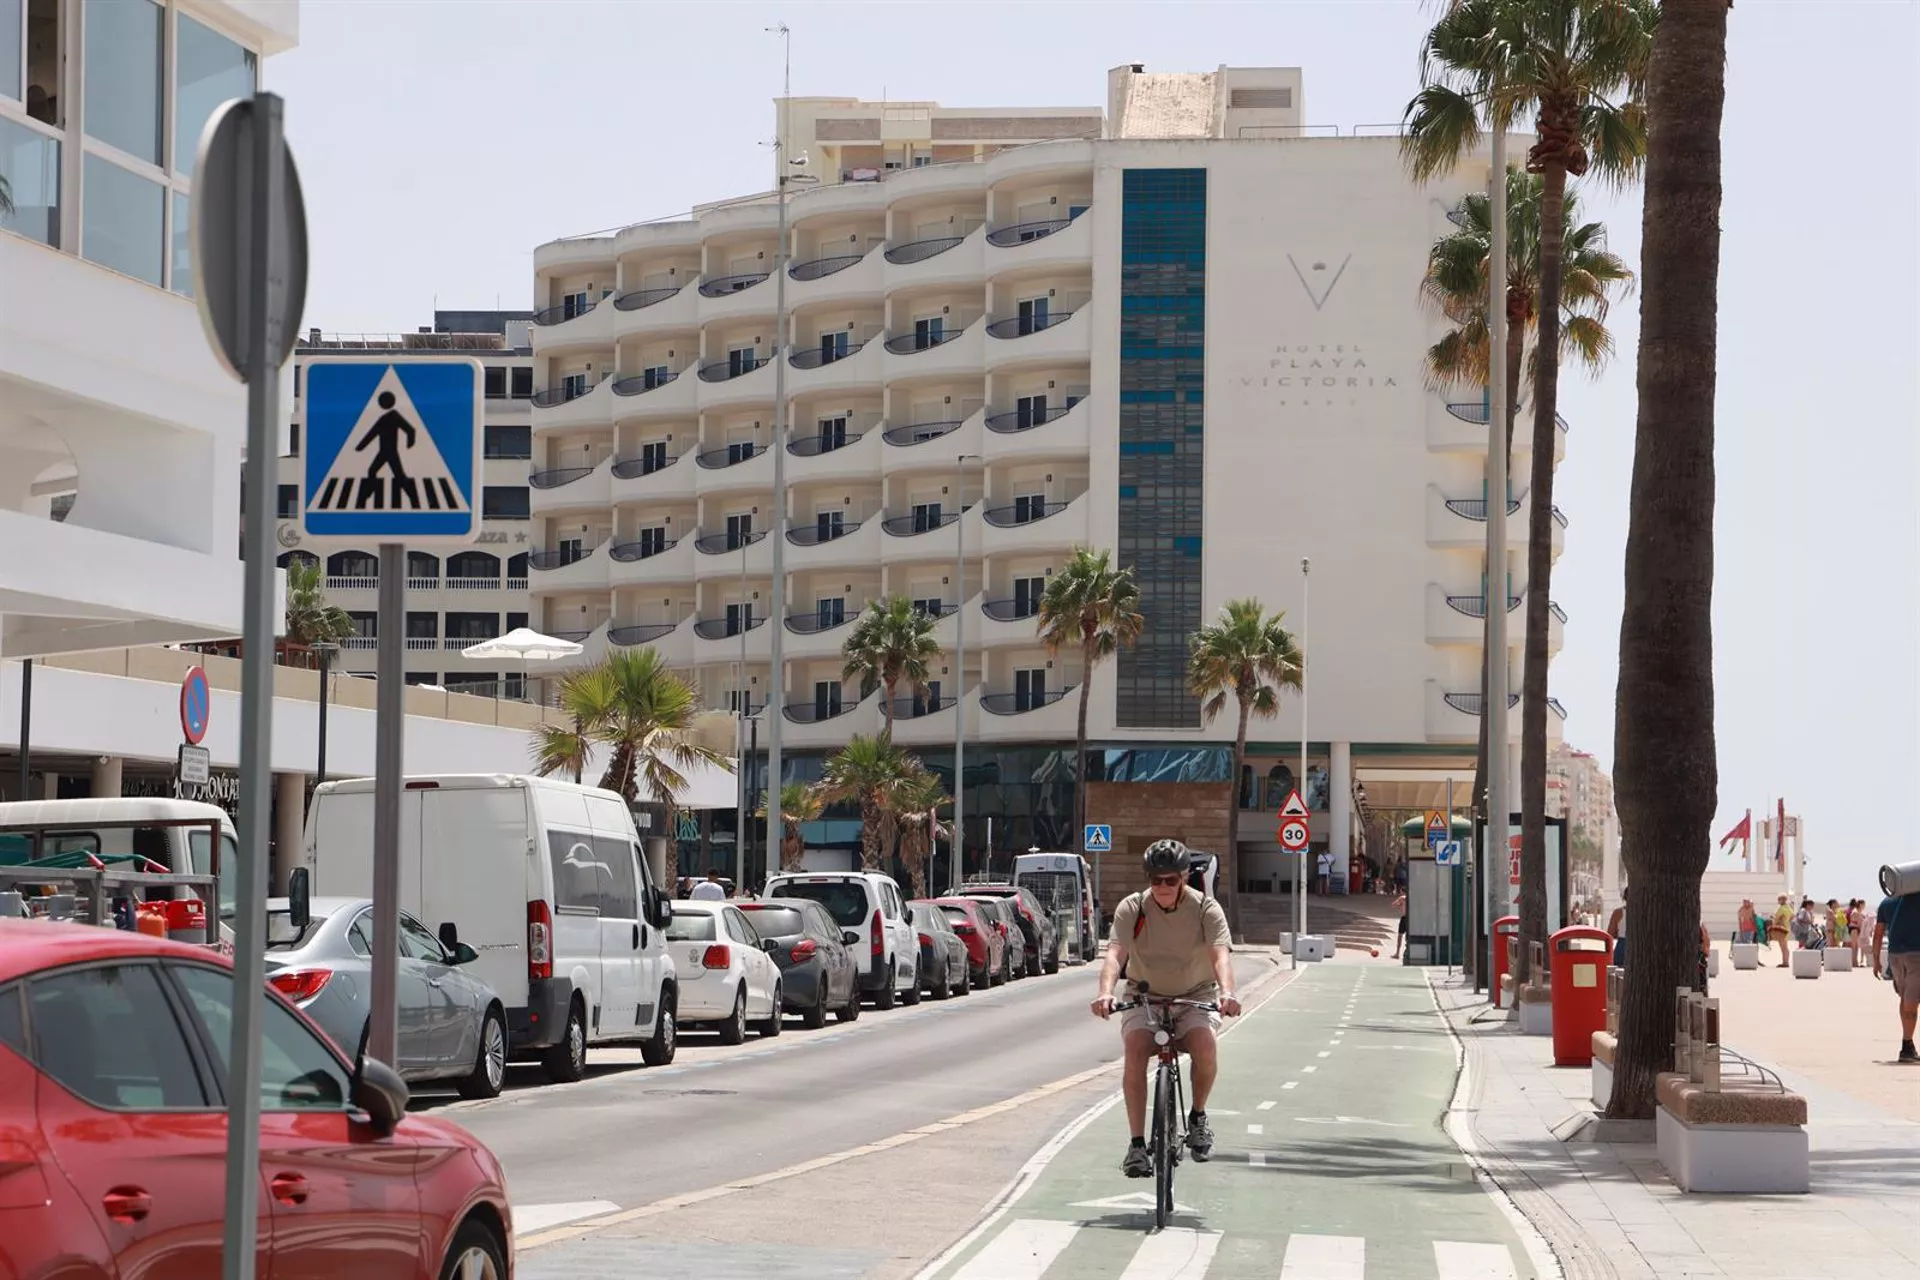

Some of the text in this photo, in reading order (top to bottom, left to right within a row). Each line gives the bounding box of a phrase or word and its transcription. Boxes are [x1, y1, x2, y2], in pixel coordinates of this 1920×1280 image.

[1275, 344, 1362, 354] HOTEL
[1269, 358, 1367, 369] PLAYA
[1240, 376, 1397, 387] VICTORIA
[1285, 829, 1304, 840] 30
